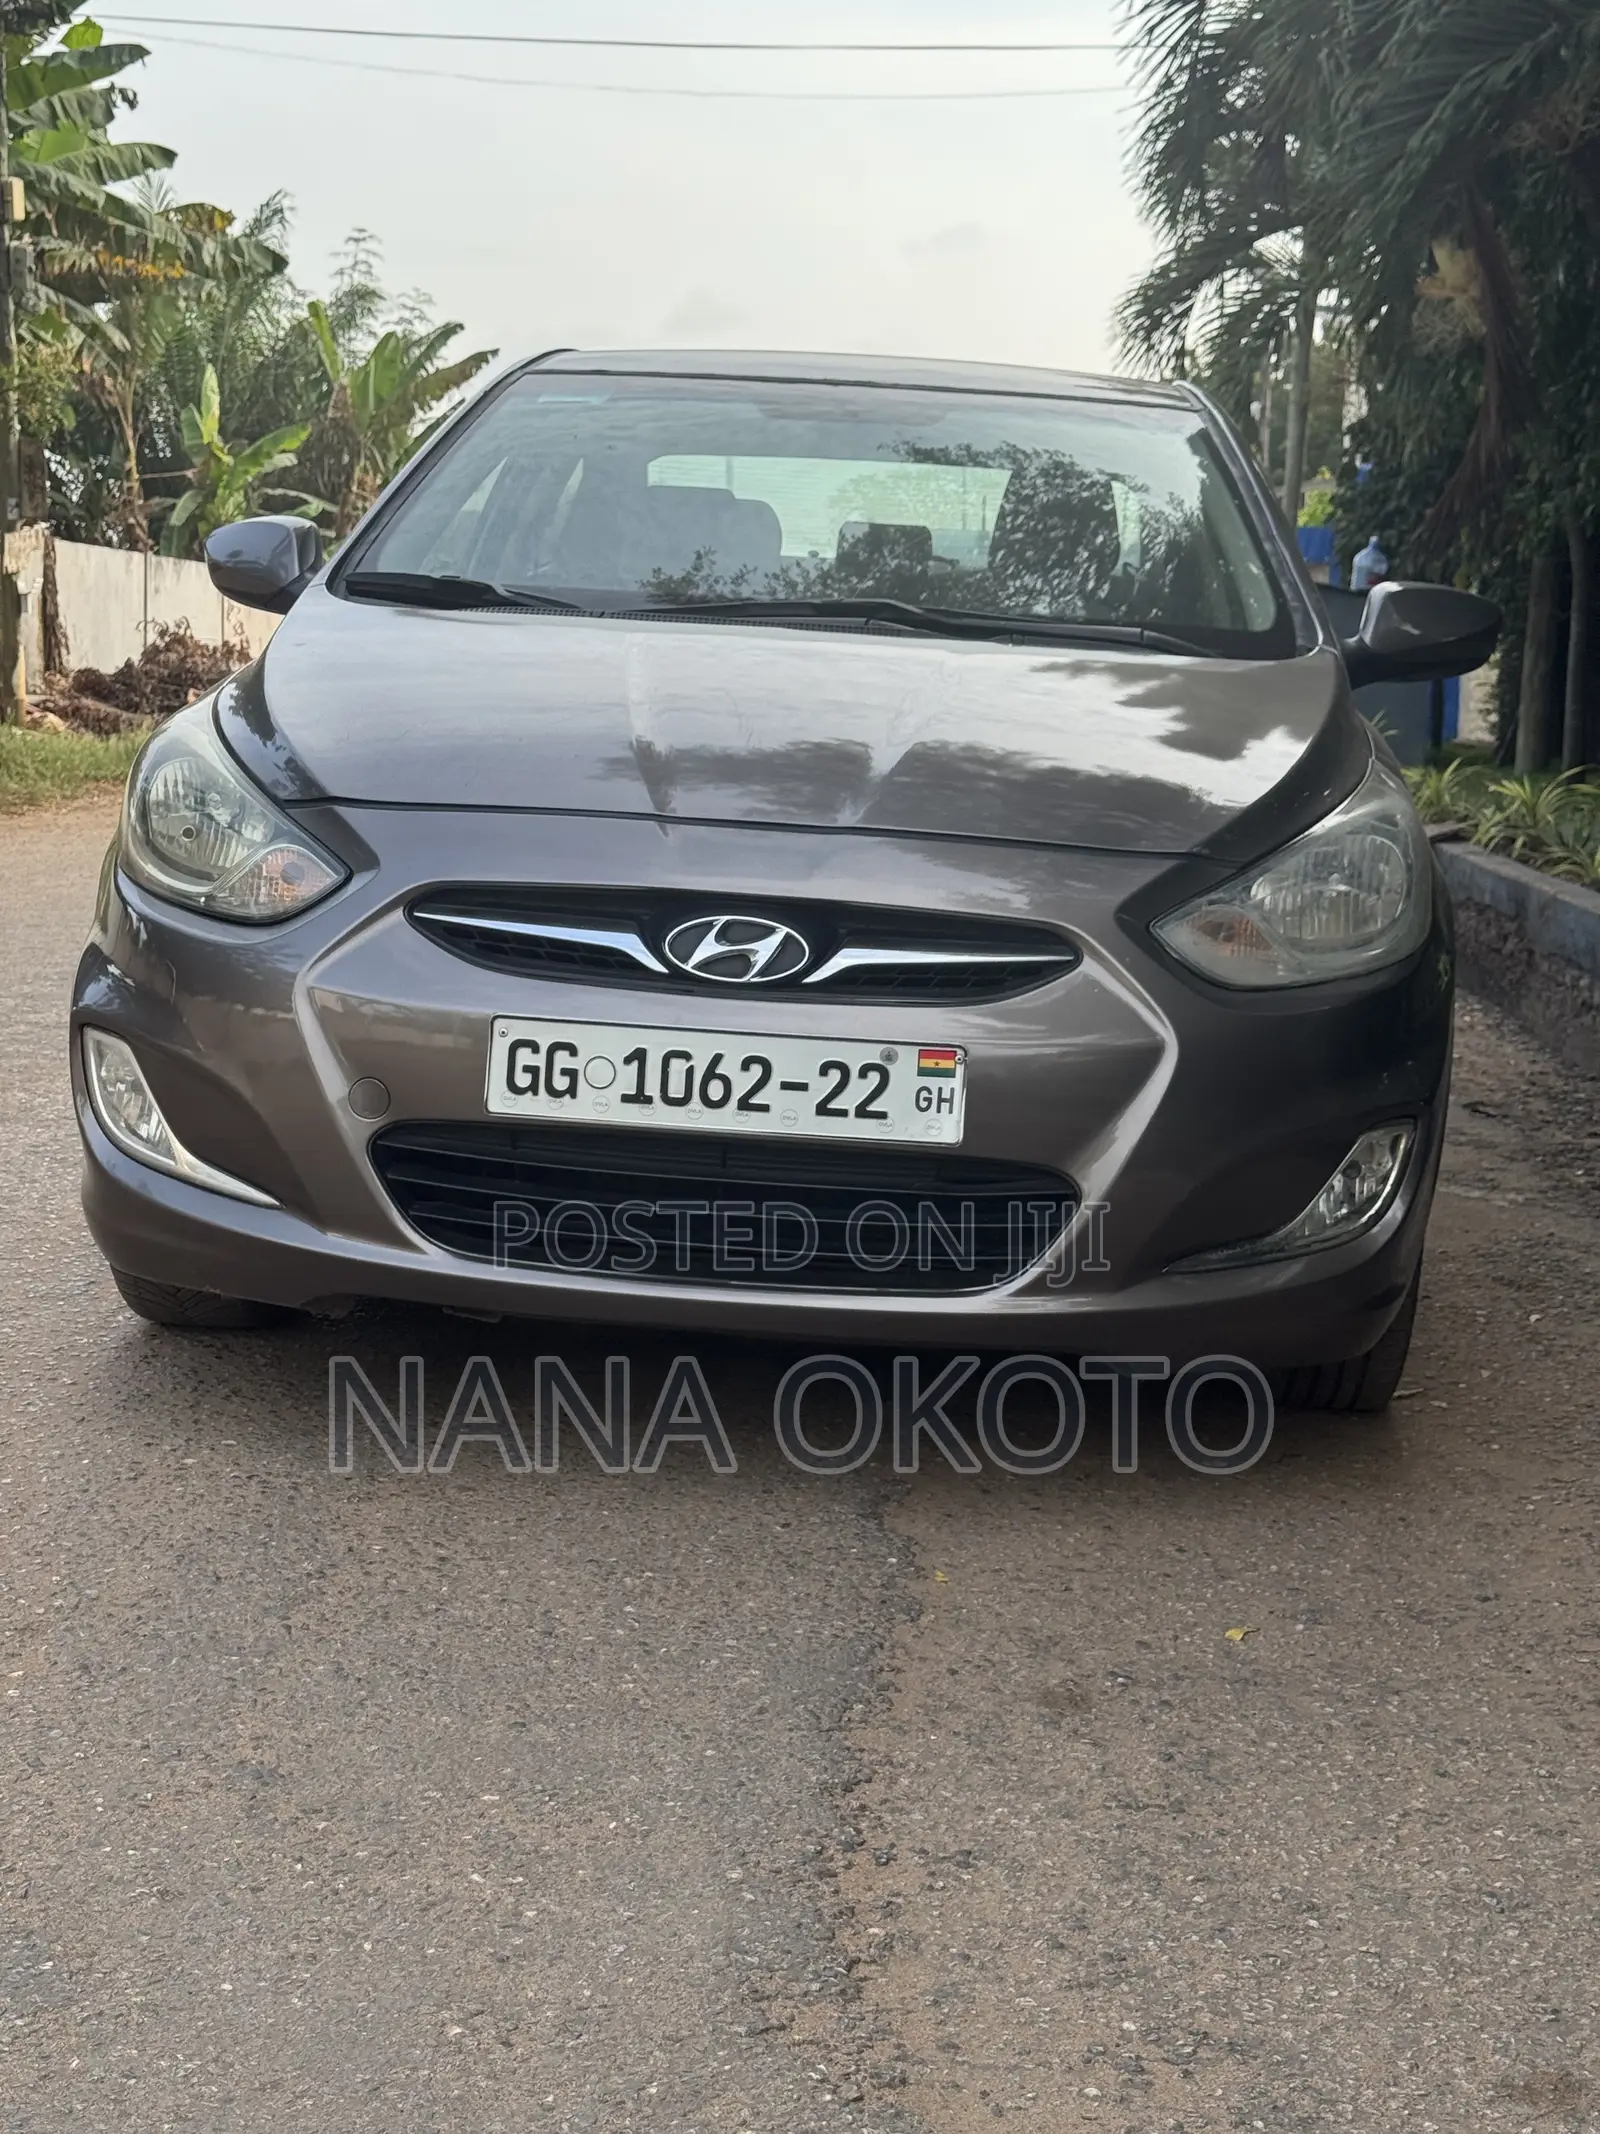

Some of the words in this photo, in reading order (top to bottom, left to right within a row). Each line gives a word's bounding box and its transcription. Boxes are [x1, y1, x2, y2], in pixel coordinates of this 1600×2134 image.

[506, 1039, 578, 1099] GG
[620, 1047, 891, 1119] 1062-22
[915, 1086, 955, 1114] GH
